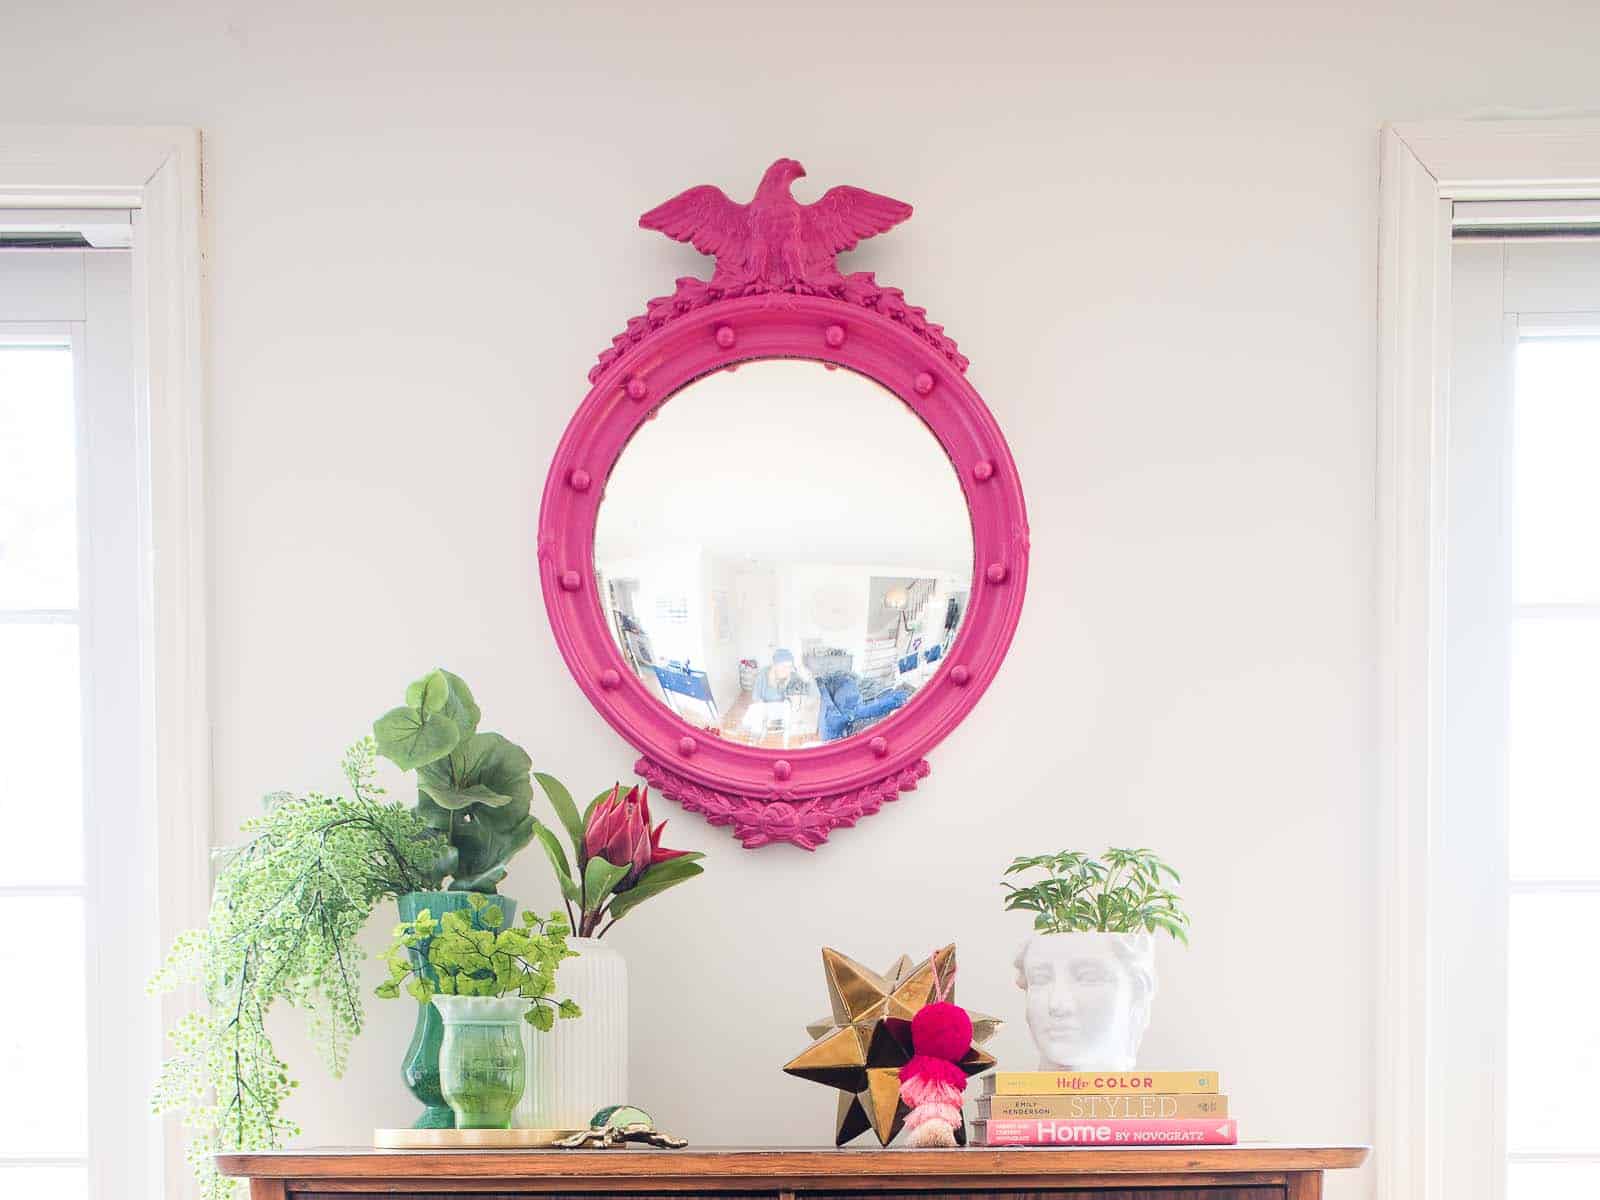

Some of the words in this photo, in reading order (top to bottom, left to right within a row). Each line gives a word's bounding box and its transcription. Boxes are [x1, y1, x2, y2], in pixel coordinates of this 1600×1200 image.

[1056, 1077, 1089, 1089] Hello
[1094, 1077, 1153, 1088] COLOR
[1070, 1096, 1178, 1119] STYLED
[1037, 1121, 1111, 1142] Home
[1115, 1130, 1129, 1141] BY
[1133, 1130, 1205, 1141] NOVOGRATZ
